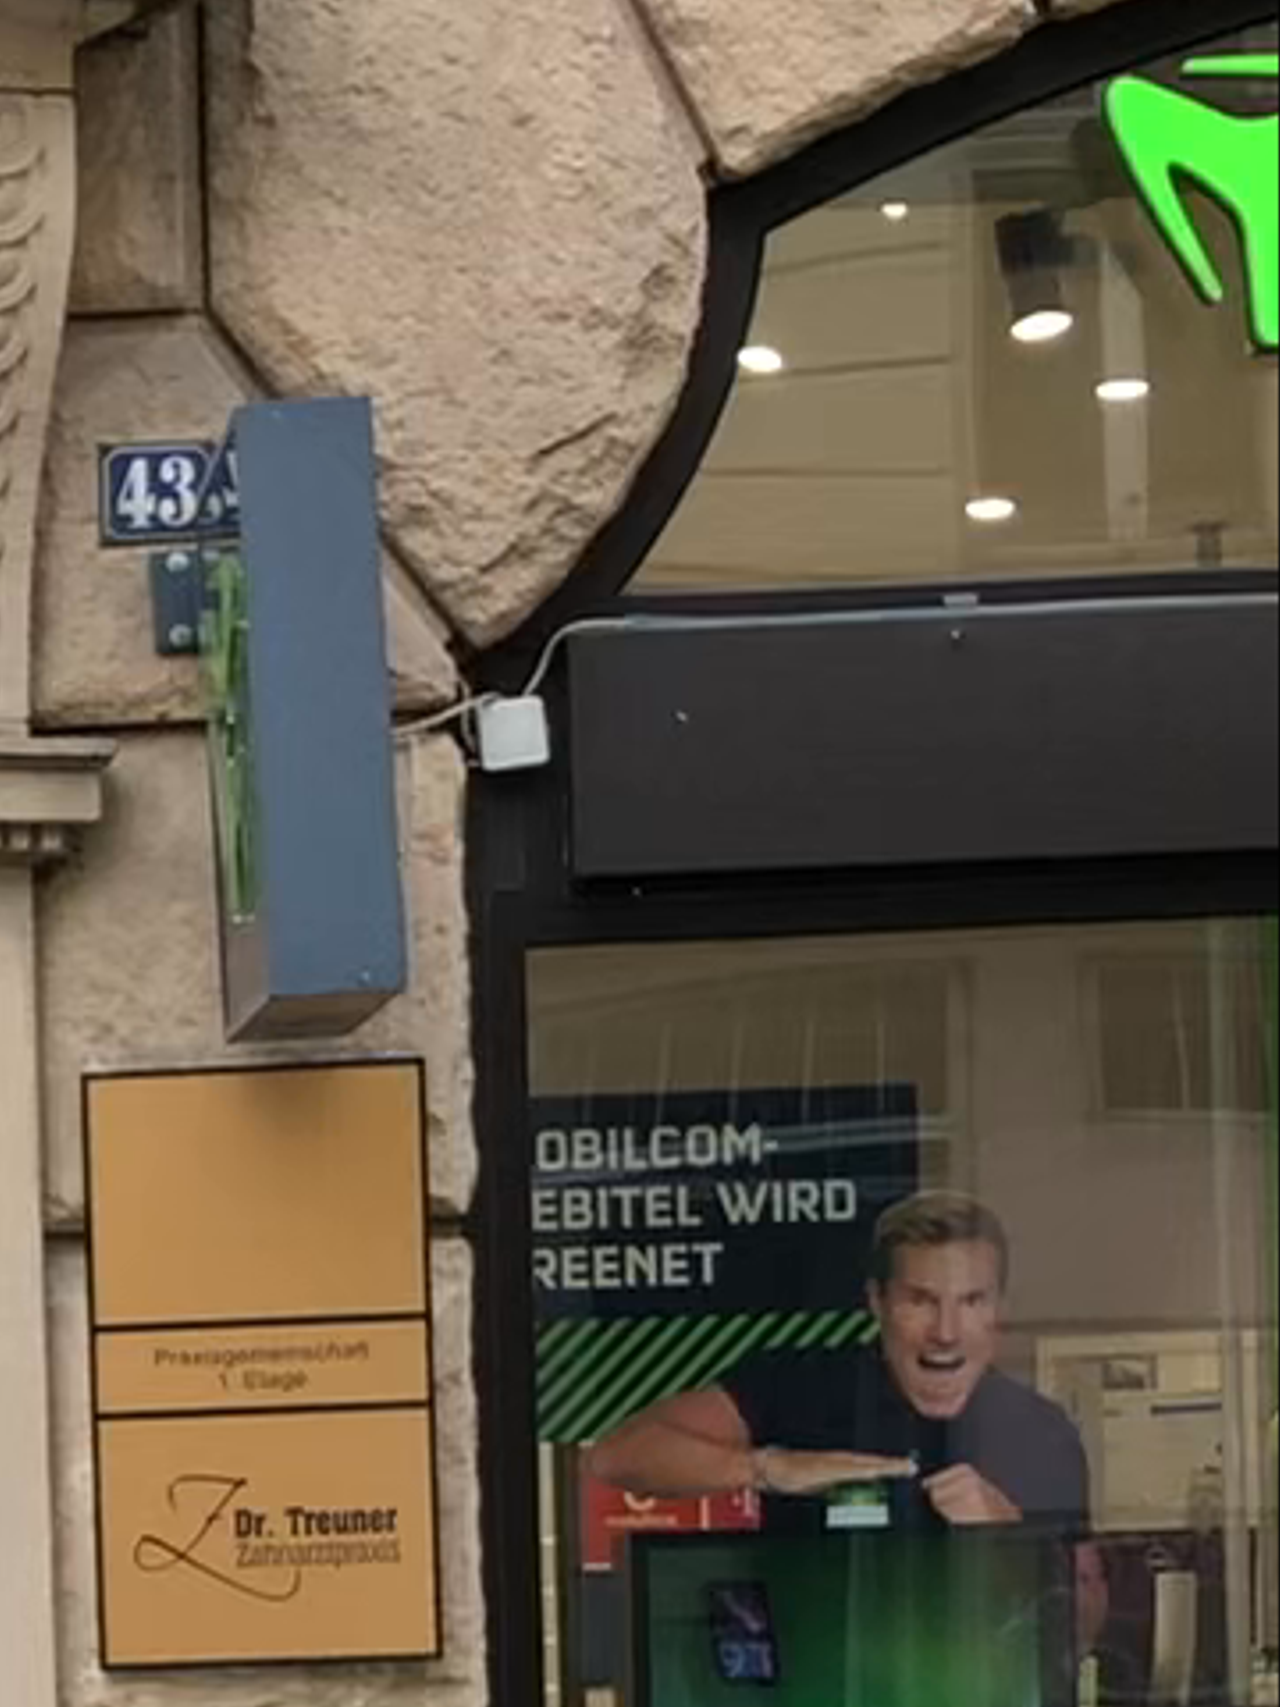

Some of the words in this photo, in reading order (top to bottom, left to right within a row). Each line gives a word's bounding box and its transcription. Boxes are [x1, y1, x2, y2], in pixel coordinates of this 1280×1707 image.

[116, 456, 197, 529] 43
[717, 1179, 856, 1225] WIRD
[234, 1507, 274, 1539] Dr.
[285, 1505, 398, 1536] Treuner
